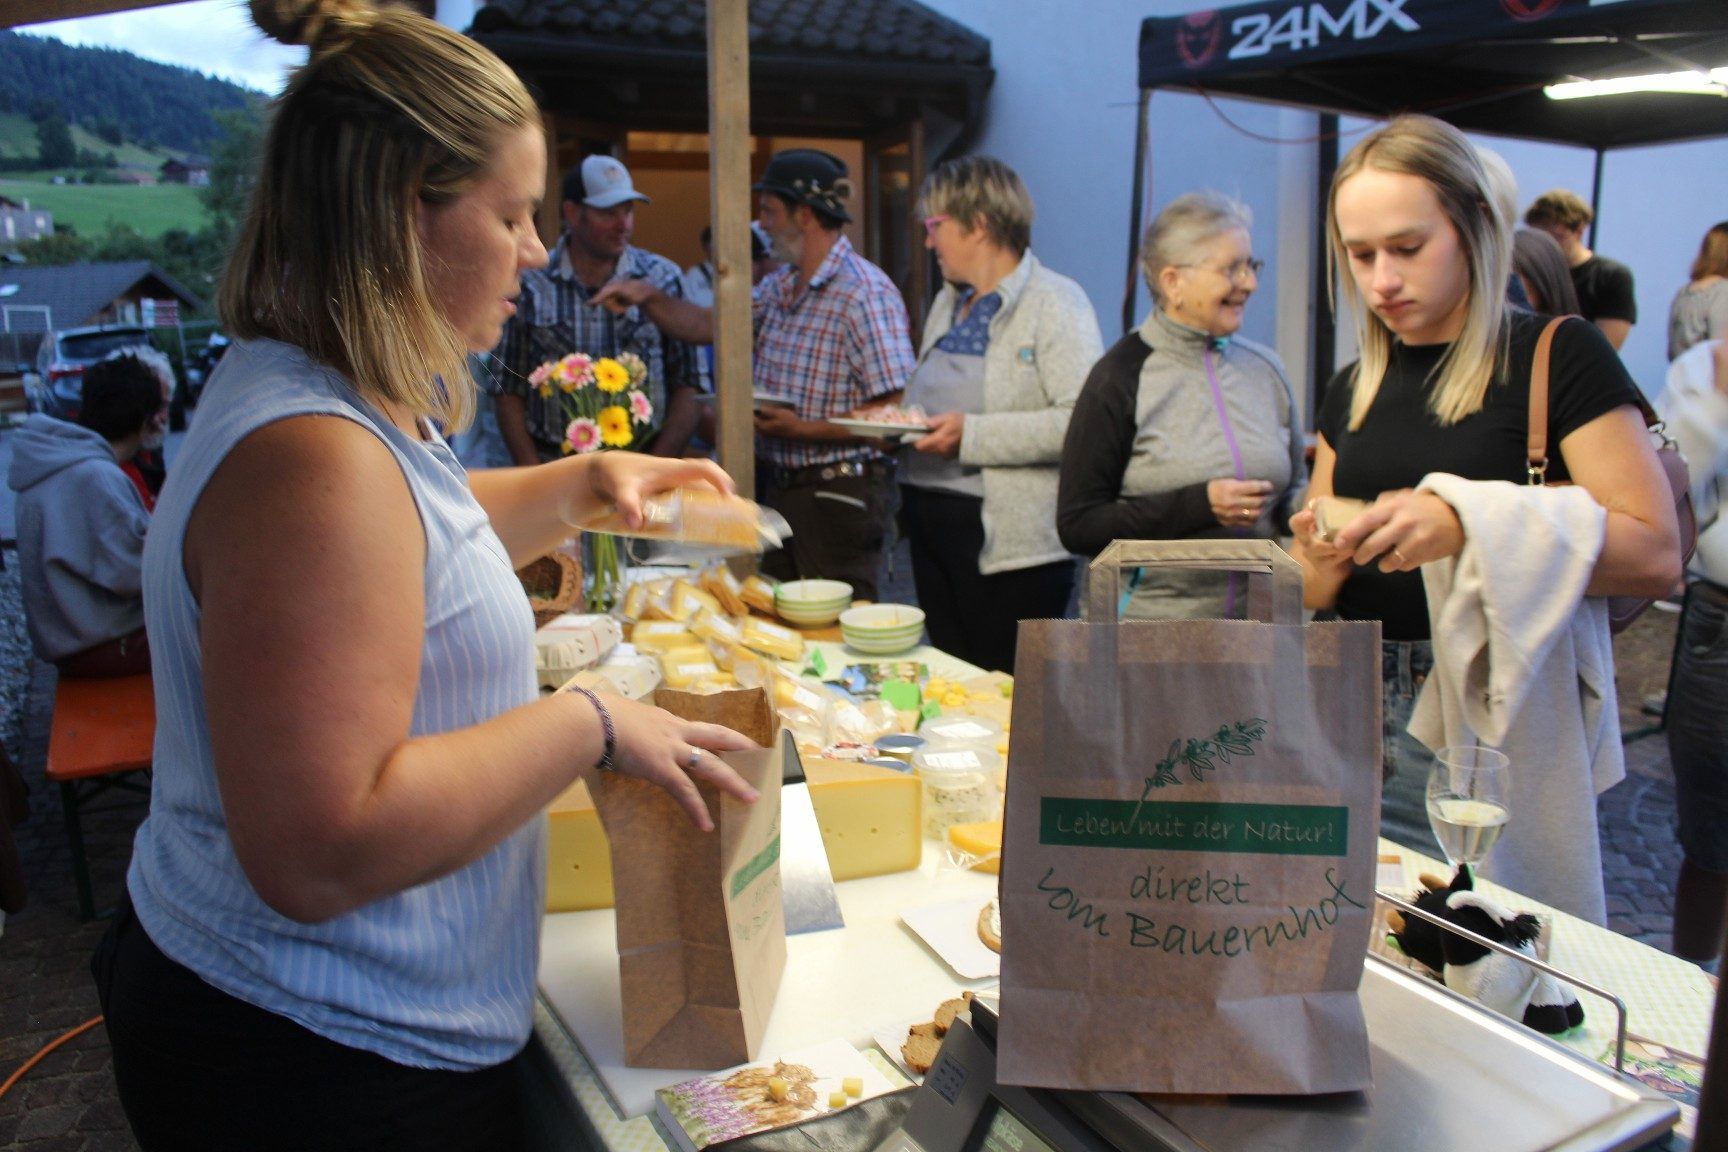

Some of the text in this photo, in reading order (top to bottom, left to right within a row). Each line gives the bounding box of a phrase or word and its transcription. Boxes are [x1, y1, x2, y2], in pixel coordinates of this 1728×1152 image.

[1228, 0, 1421, 59] 24MX
[1057, 811, 1333, 843] Leben mit der Natur!
[1130, 866, 1250, 905] direkt
[1126, 867, 1367, 958] Bauernhof
